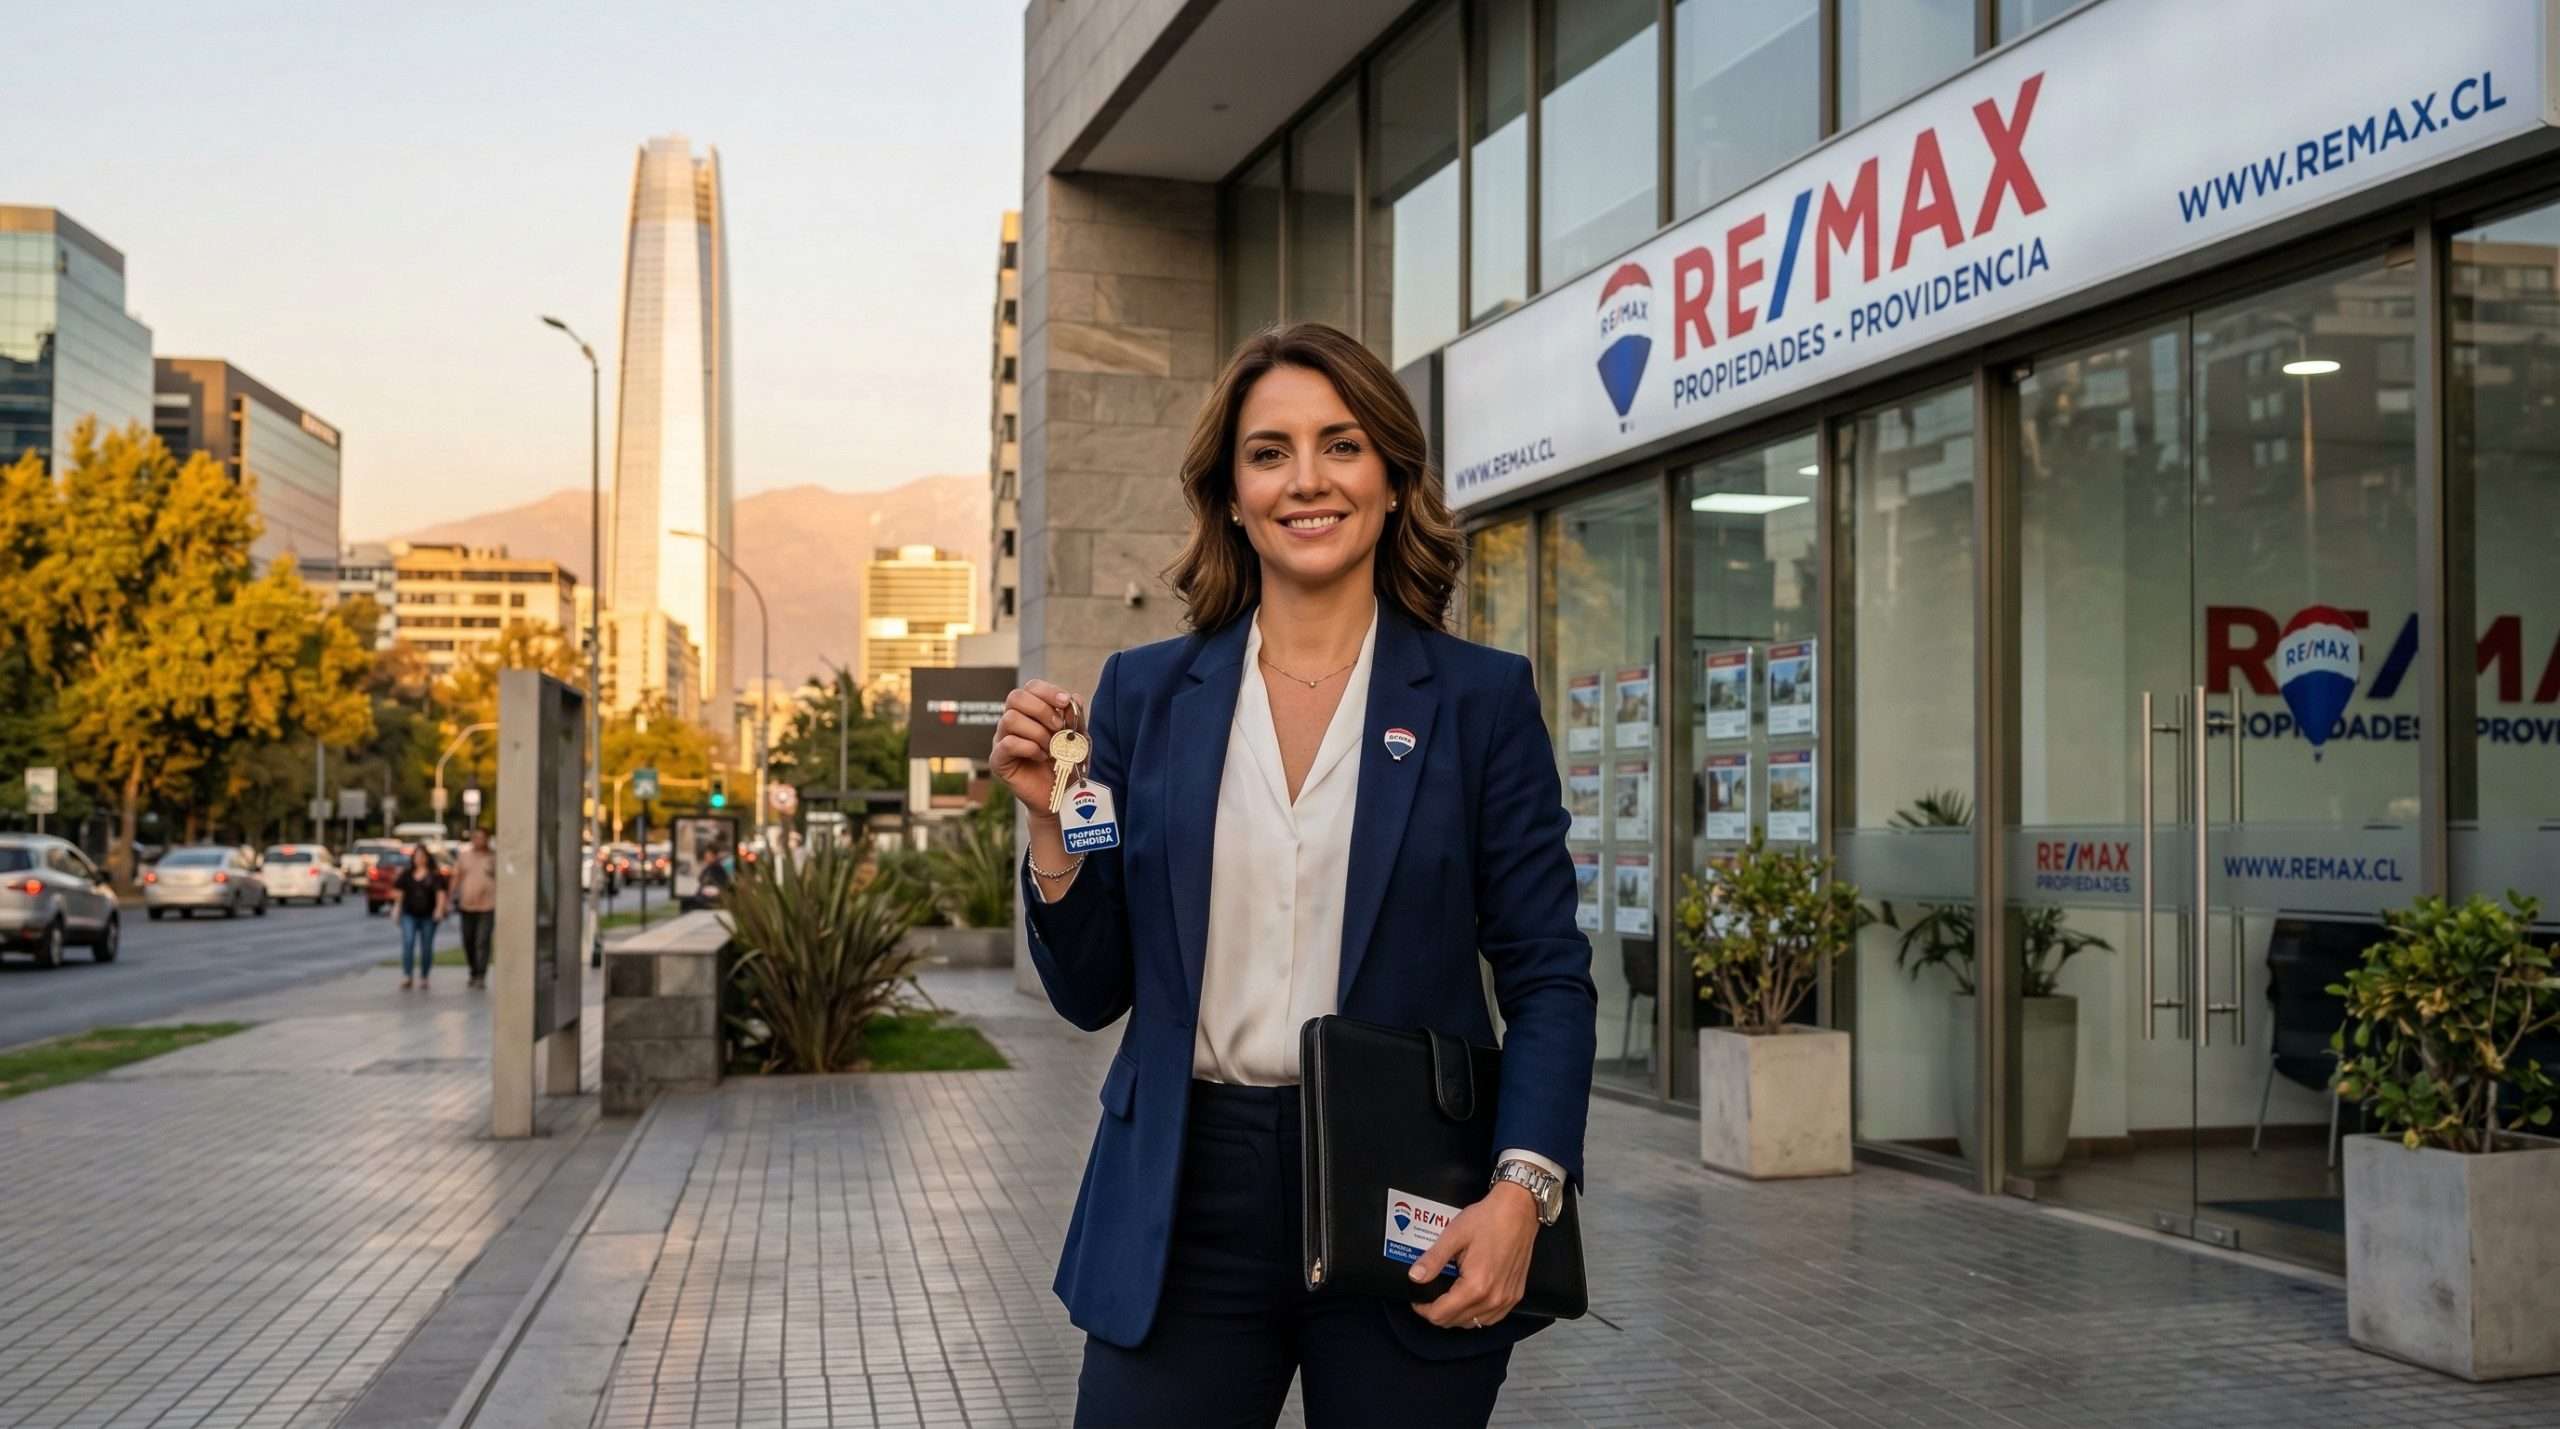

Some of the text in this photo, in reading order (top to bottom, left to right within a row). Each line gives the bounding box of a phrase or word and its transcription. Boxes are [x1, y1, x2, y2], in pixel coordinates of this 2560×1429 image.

[2178, 71, 2507, 223] WWW.REMAX.CL
[1673, 71, 2048, 361] RE/MAX
[1674, 323, 1826, 409] PROPIEDADES
[1850, 236, 2050, 342] PROVIDENCIA
[1454, 436, 1556, 490] WWW.REMAX.CL
[2286, 637, 2350, 668] RE/MAX
[2036, 842, 2131, 872] RE/MAX
[2223, 855, 2403, 883] WWW.REMAX.CL
[2036, 875, 2131, 894] PROPIEDADES
